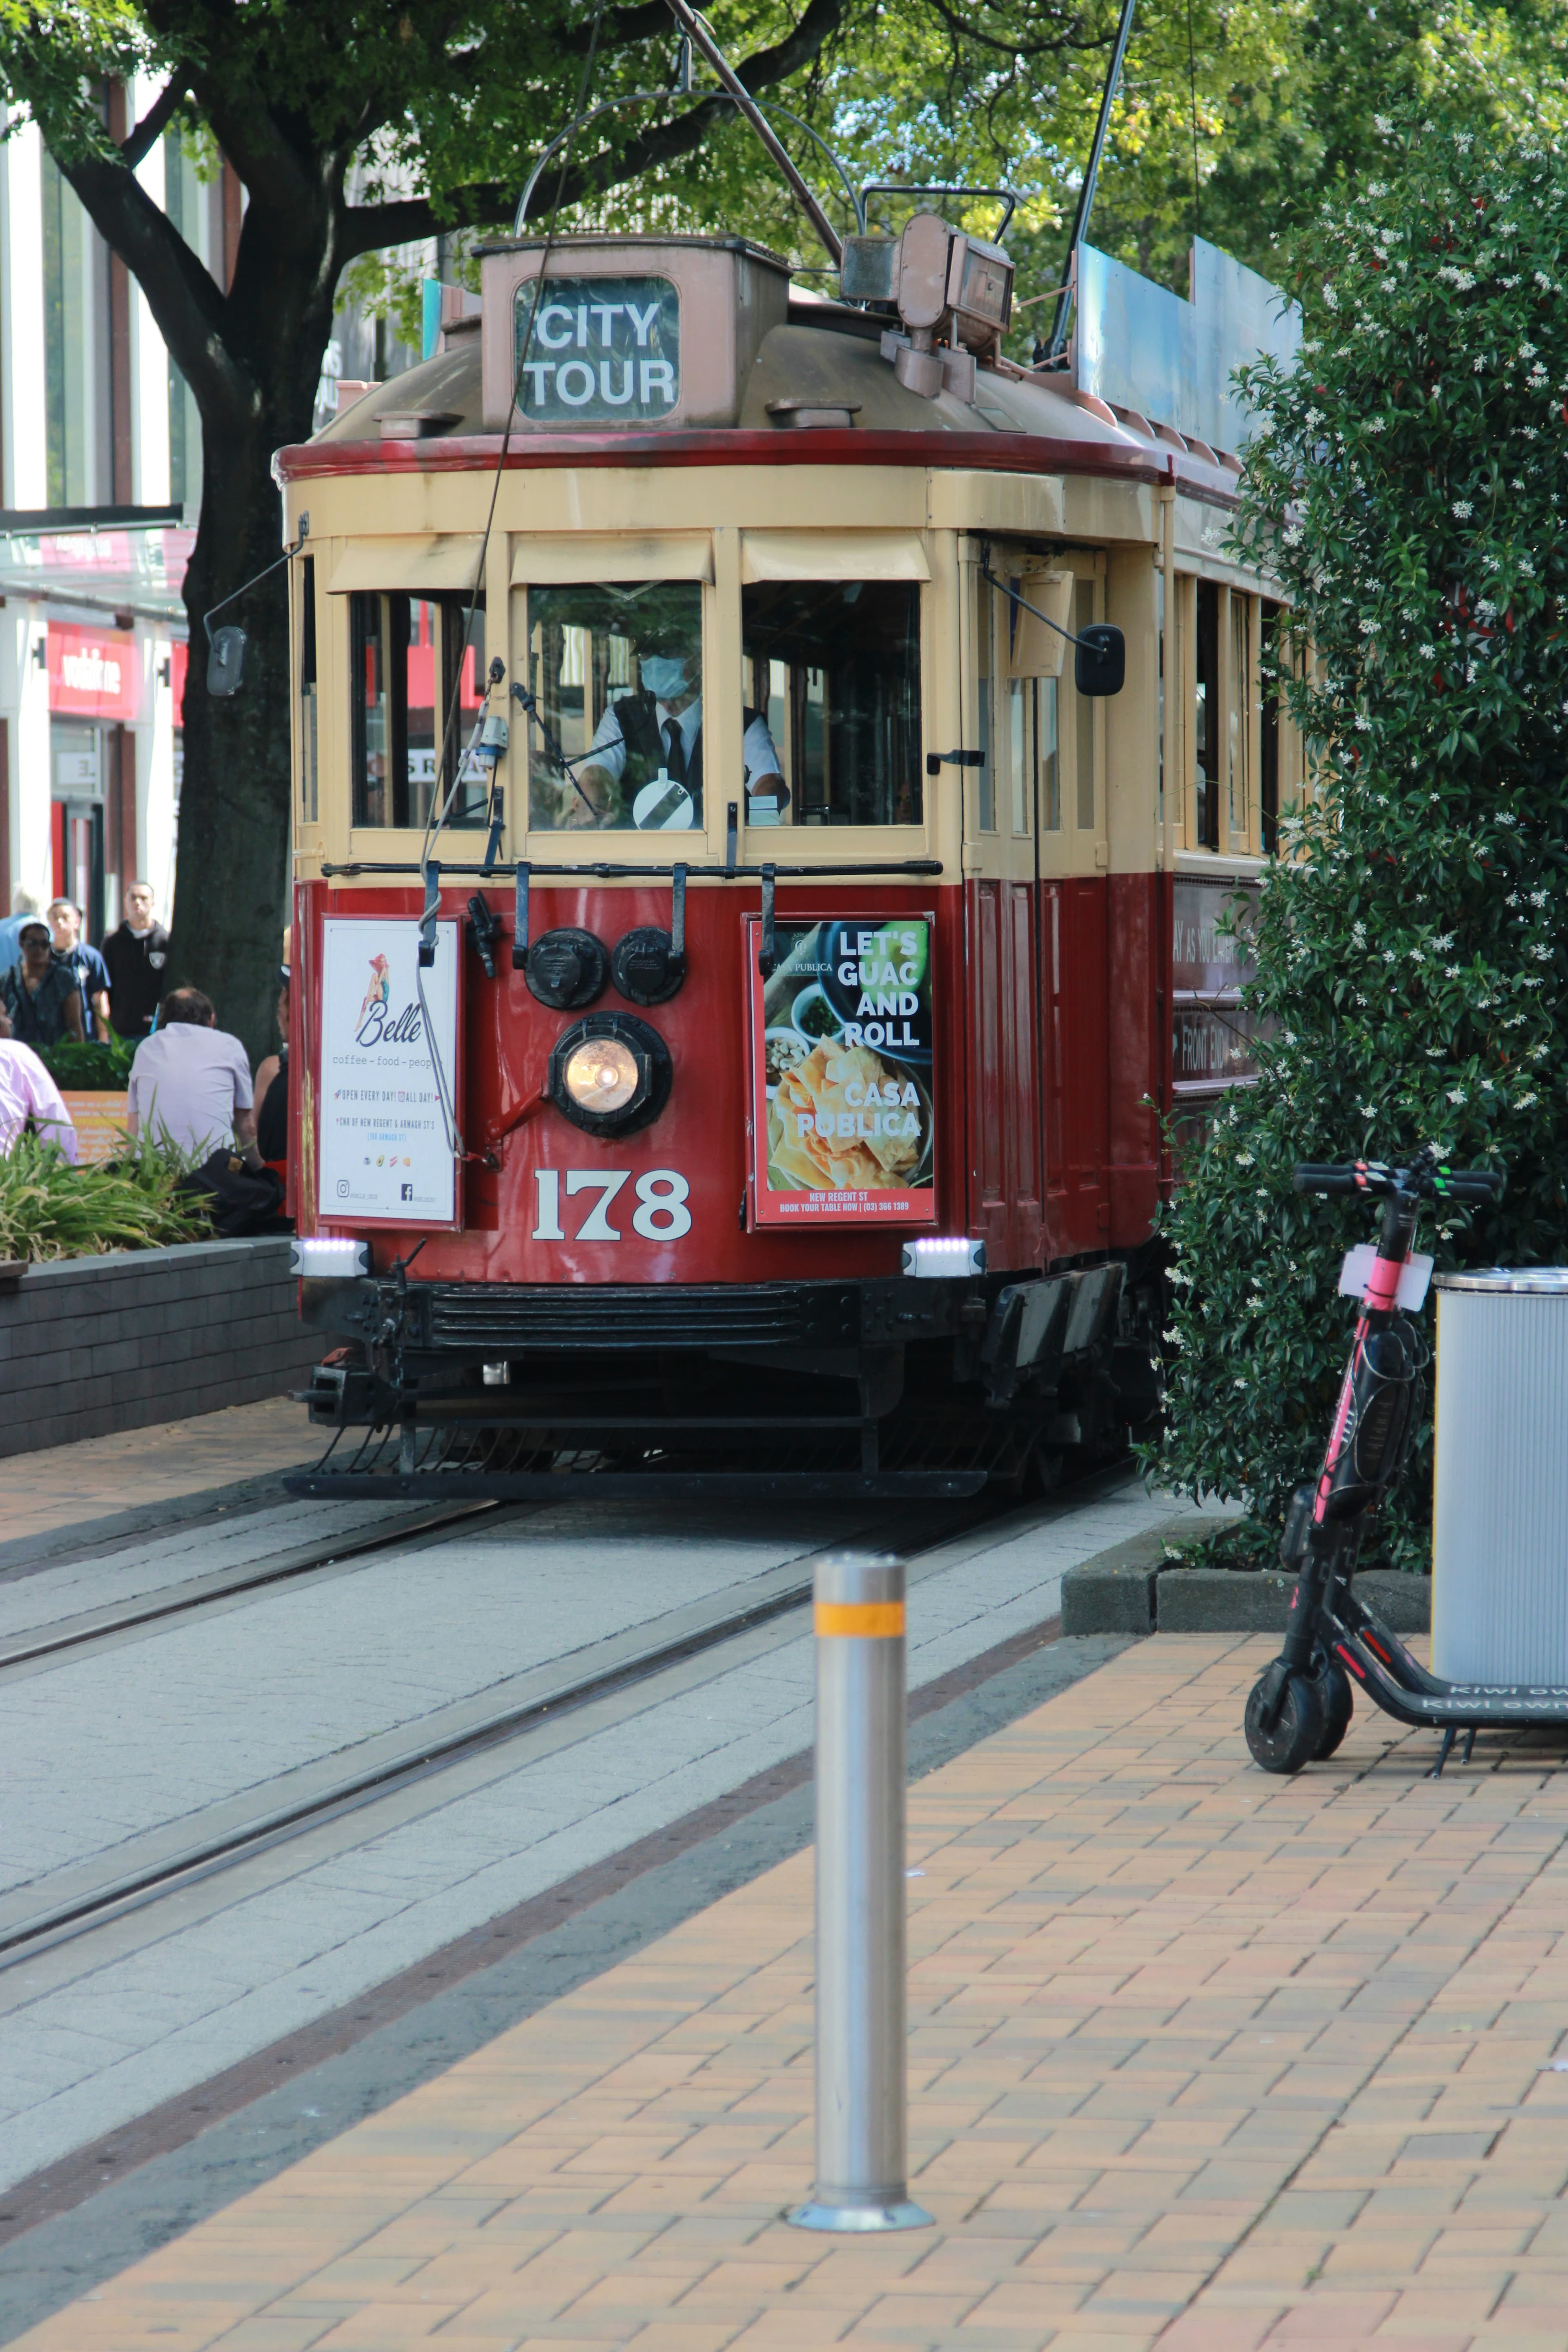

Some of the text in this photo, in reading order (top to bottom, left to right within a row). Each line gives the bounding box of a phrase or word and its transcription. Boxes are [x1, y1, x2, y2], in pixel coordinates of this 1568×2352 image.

[537, 303, 660, 349] CITY
[523, 359, 675, 406] TOUR
[840, 931, 917, 956] LET'S
[1187, 928, 1195, 963] AS
[1198, 928, 1210, 963] YOU
[838, 961, 918, 986] GUAC
[856, 992, 919, 1016] AND
[356, 1000, 421, 1047] Belle
[845, 1022, 920, 1046] ROLL
[1183, 1025, 1224, 1070] FRONT END
[332, 1055, 367, 1065] coffee
[377, 1056, 399, 1065] food
[409, 1059, 432, 1069] peop
[342, 1090, 433, 1102] OPEN EVERY DAY! ALL DAY!
[844, 1082, 920, 1107] CASA
[339, 1117, 350, 1126] CNR
[352, 1118, 359, 1126] OF
[360, 1118, 371, 1127] NEW
[373, 1119, 392, 1128] REGENT
[400, 1120, 421, 1129] ARMAGH
[797, 1112, 921, 1137] PUBLICA
[532, 1169, 692, 1241] 178
[780, 1204, 799, 1212] BOOK
[801, 1203, 819, 1212] YOUR
[821, 1203, 841, 1212] TABLE
[843, 1203, 858, 1212] NOW
[864, 1203, 877, 1212] (03)
[879, 1203, 891, 1211] 366
[893, 1202, 909, 1210] 1389
[810, 1192, 868, 1202] NEW REGENT ST
[1451, 1686, 1517, 1694] Kiwi
[1423, 1699, 1490, 1708] Kiwi
